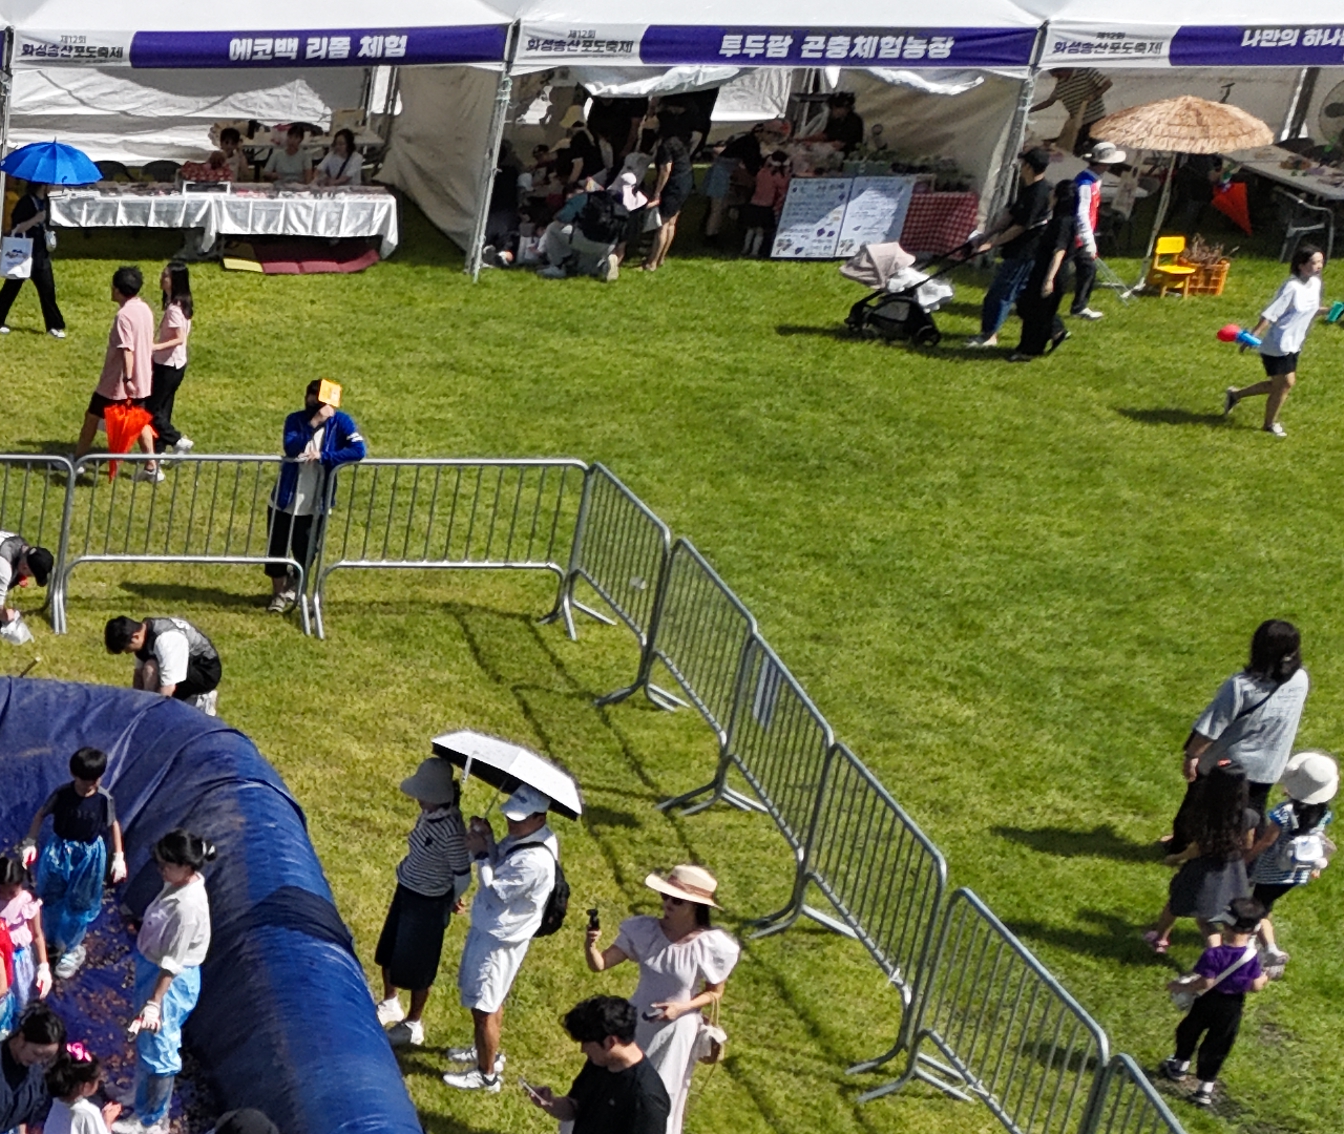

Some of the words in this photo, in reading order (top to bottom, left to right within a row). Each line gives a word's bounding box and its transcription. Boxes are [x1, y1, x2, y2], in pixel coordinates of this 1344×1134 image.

[60, 35, 86, 44] 제12회
[567, 29, 595, 39] 제12회
[1241, 28, 1300, 47] 나만의
[1302, 28, 1344, 47] 하나
[21, 43, 124, 59] 화성송산포도축제
[229, 37, 299, 61] 에코백
[305, 36, 351, 60] 리폼
[357, 35, 408, 58] 체험
[526, 38, 633, 53] 화성송산포도축제
[719, 34, 793, 58] 투두팜
[800, 35, 954, 59] 곤충체험농장
[1052, 41, 1163, 55] 화성송산포도축제
